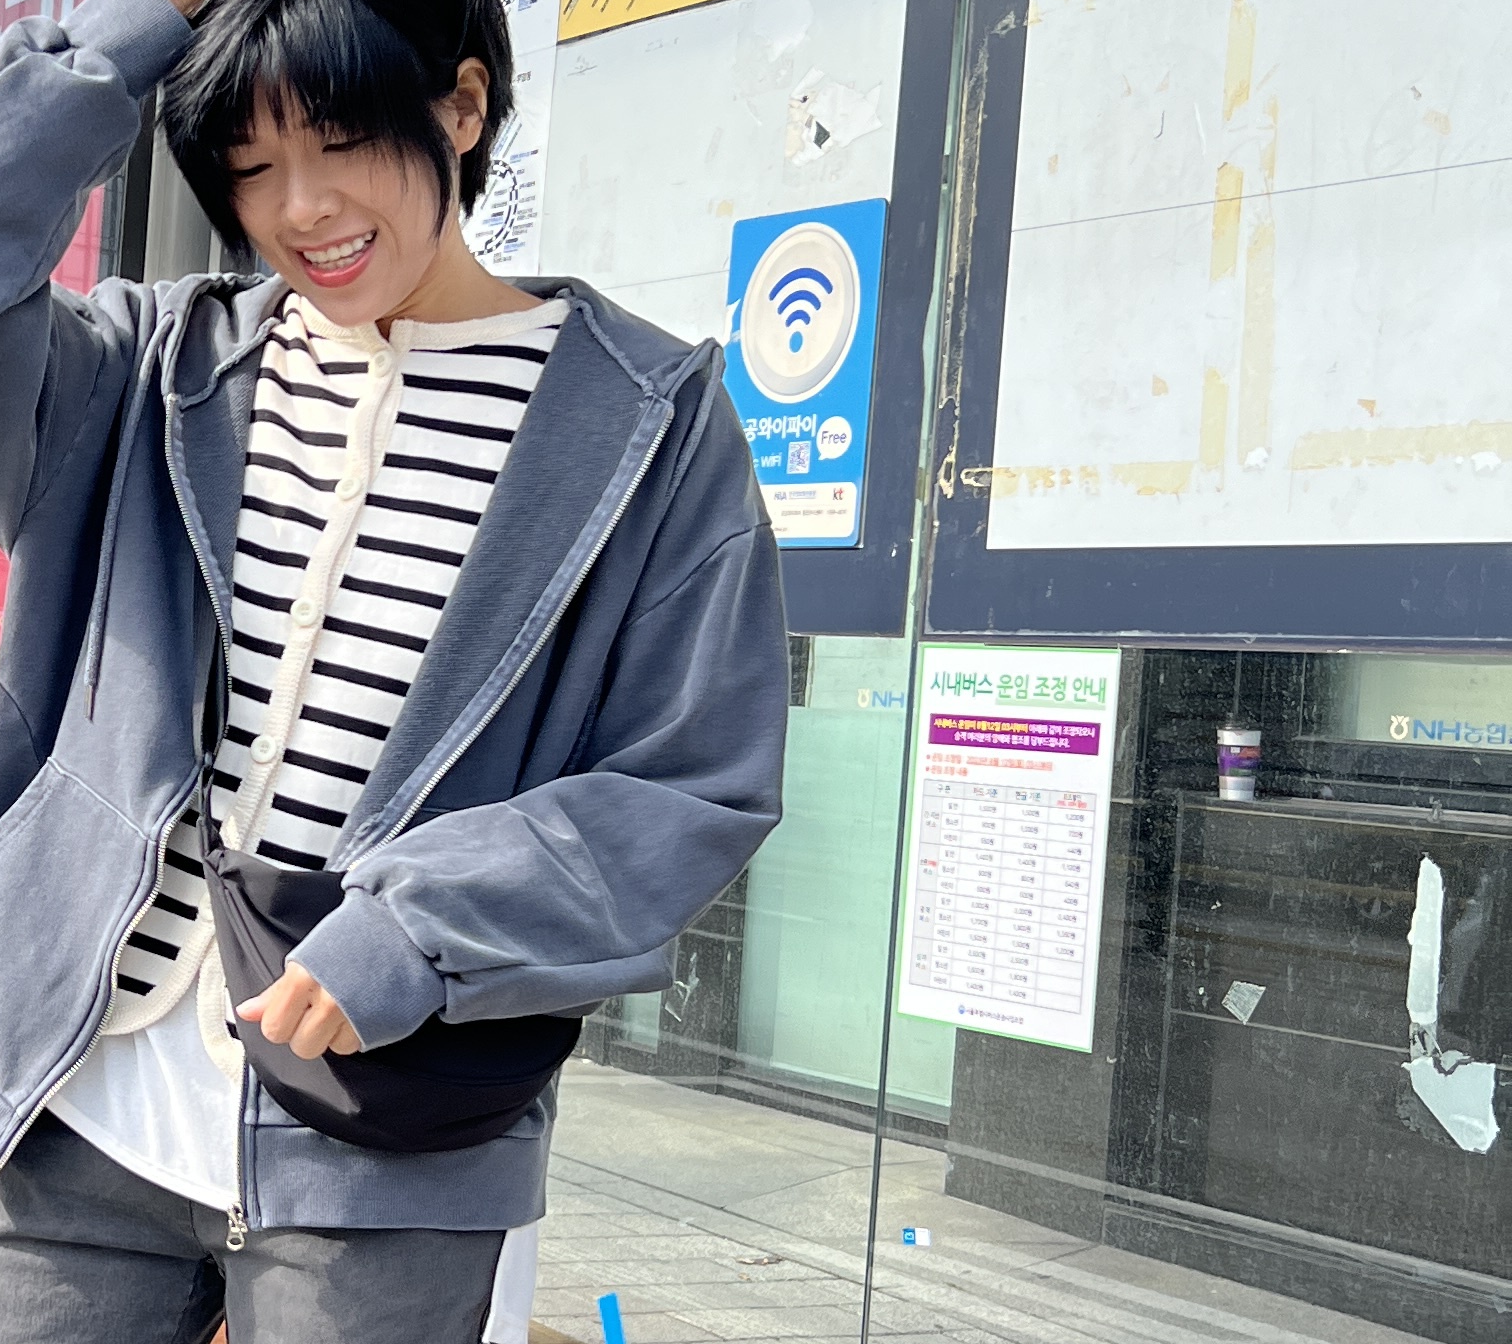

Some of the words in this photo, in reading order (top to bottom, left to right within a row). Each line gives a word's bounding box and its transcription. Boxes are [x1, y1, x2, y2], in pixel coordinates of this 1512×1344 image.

[740, 413, 817, 442] 공와이파이
[820, 430, 848, 445] Free
[930, 670, 993, 697] 시내버스
[996, 673, 1030, 700] 운임
[1033, 675, 1068, 702] 조정
[1072, 676, 1107, 704] 안내
[871, 690, 906, 709] NH
